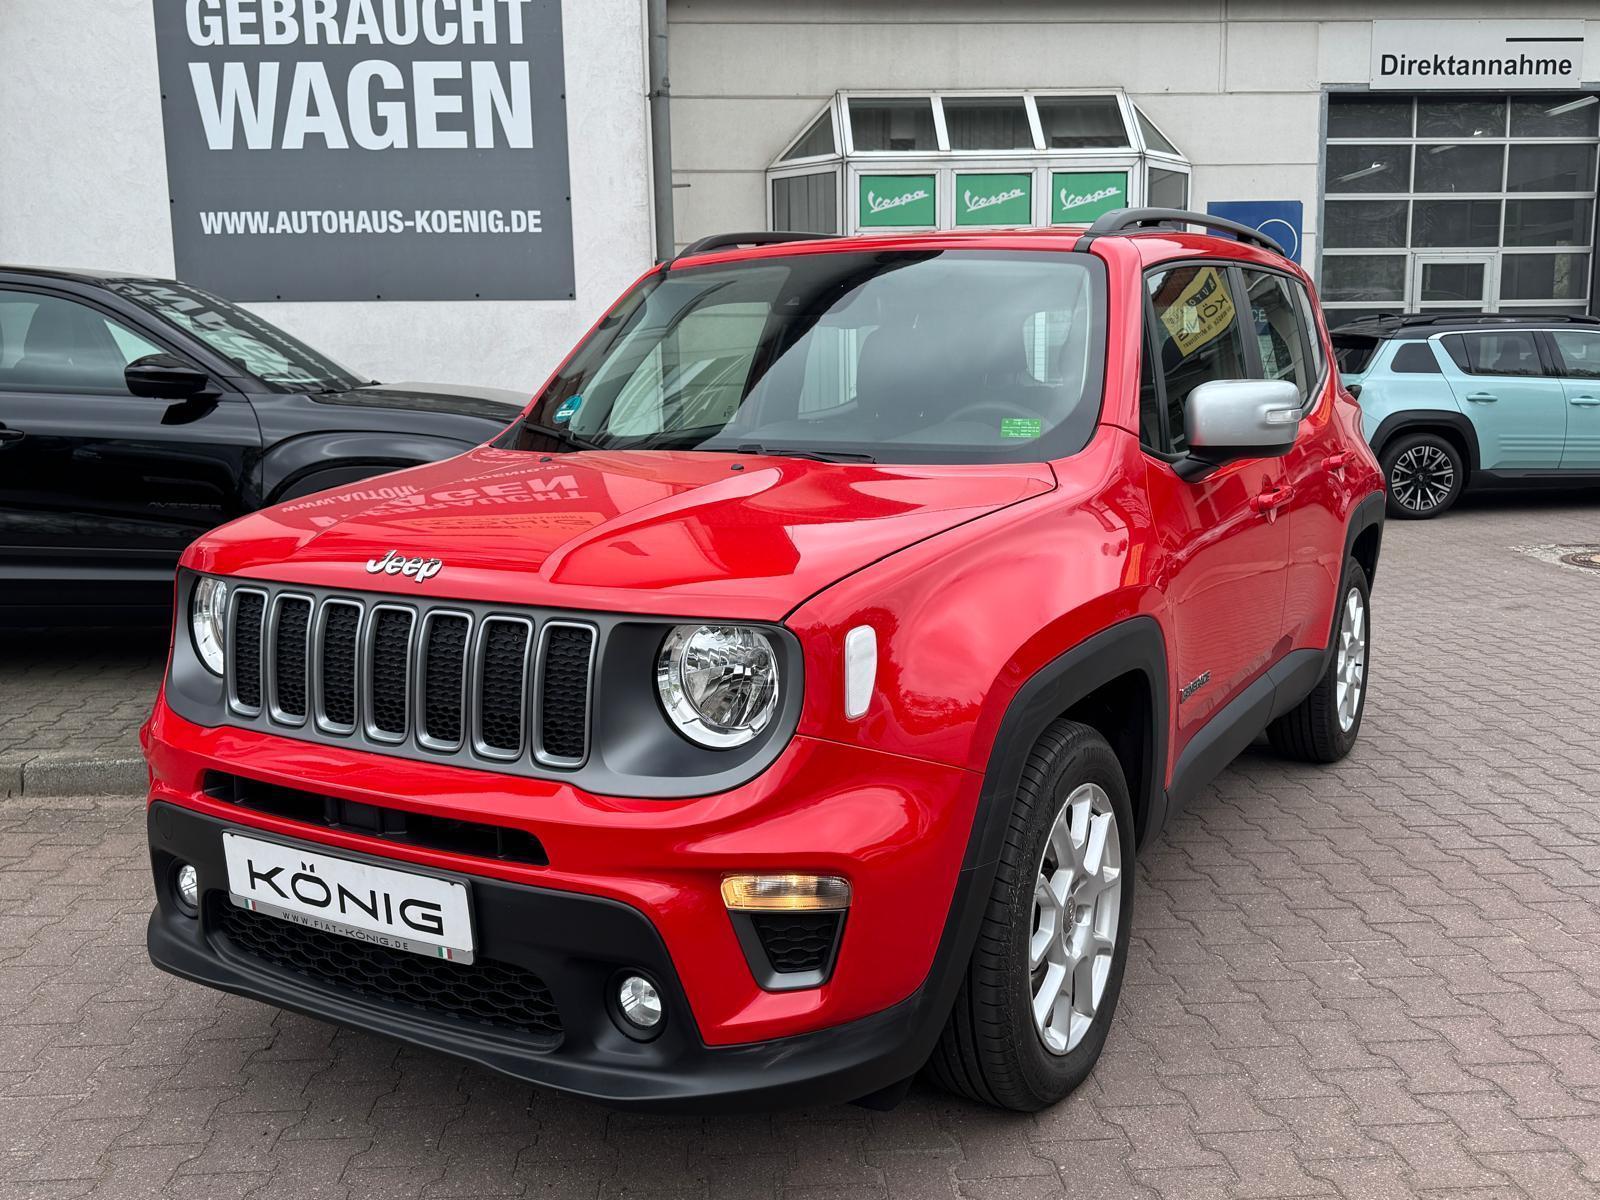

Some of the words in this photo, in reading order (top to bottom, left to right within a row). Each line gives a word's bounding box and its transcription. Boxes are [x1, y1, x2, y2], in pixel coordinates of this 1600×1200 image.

[184, 0, 531, 46] GEBRAUCHT
[1380, 53, 1573, 76] Direktannahme
[187, 59, 534, 151] WAGEN
[867, 190, 930, 214] Vespa
[963, 188, 1026, 213] Vespa
[1059, 187, 1122, 211] Vespa
[199, 210, 543, 235] WWW.AUTOHAUS-KOENIG.DE
[365, 549, 443, 584] Jeep
[247, 859, 445, 936] KÖNIG
[281, 911, 410, 951] WWW.FIAT-KÖNIG.DE
